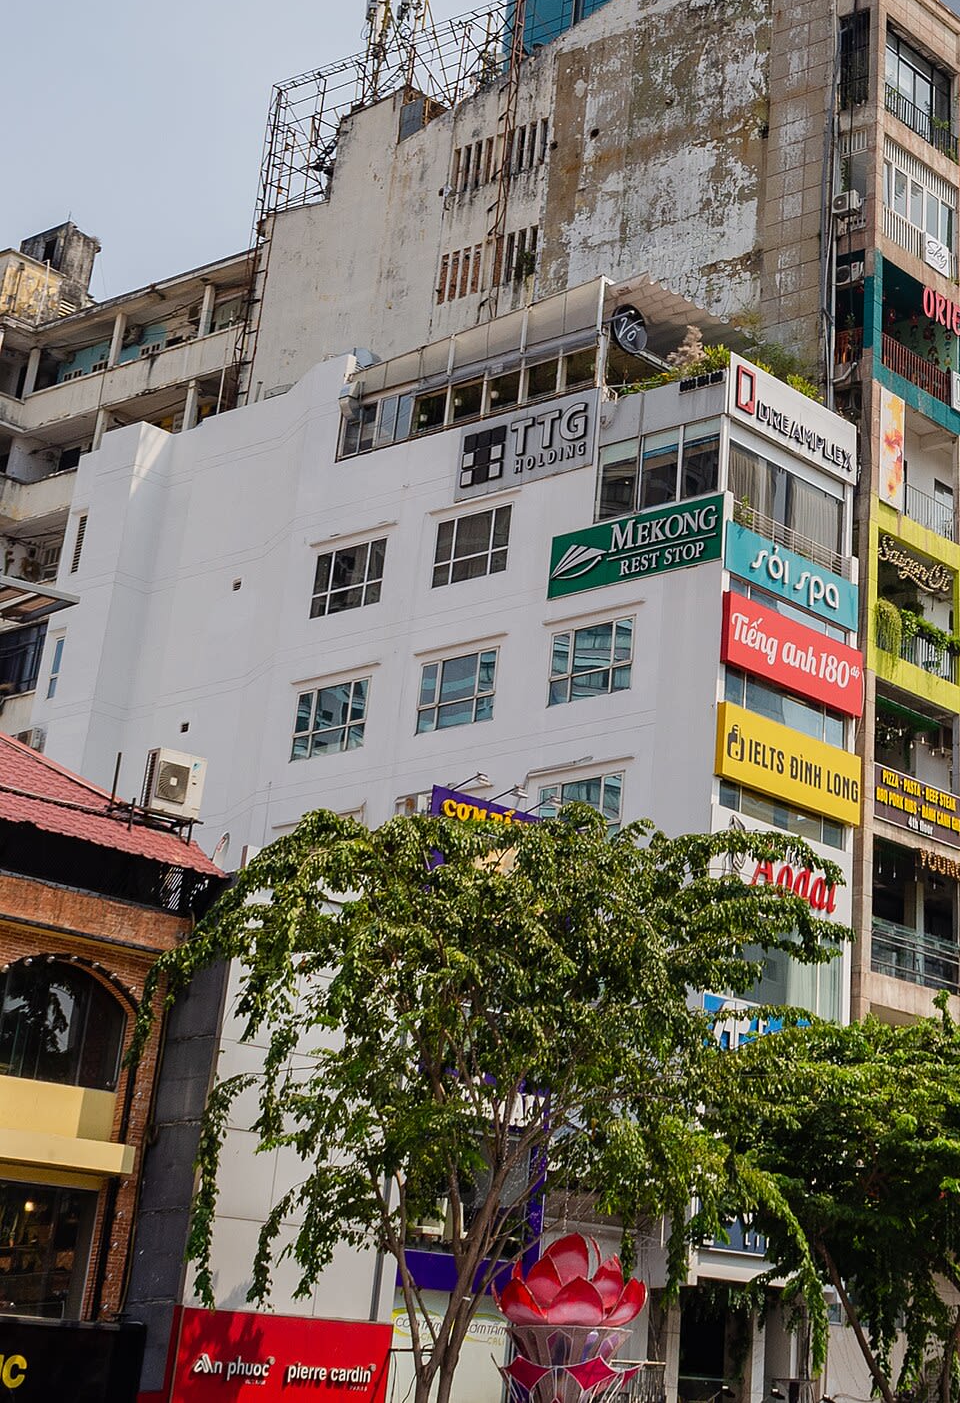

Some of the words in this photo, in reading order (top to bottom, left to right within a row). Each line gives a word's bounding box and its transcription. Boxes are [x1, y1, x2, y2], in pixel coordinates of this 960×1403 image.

[511, 401, 588, 456] TTG
[757, 400, 853, 472] DREAMPLEX
[514, 442, 586, 474] HOLDING
[608, 505, 718, 553] MEKONG
[619, 551, 660, 576] REST
[663, 541, 704, 565] STOP
[731, 612, 779, 666] Tiếng
[819, 652, 850, 689] 180
[749, 739, 785, 775] IELTS
[790, 754, 822, 789] ĐÌNH
[827, 770, 859, 803] LONG
[882, 769, 899, 788] PIZZA
[903, 778, 921, 797] PASTA
[925, 787, 939, 805] BEEF
[939, 792, 957, 812] STEAK
[888, 791, 904, 810] PORK
[904, 798, 918, 815] RIBS
[907, 816, 919, 830] 4th
[227, 1355, 269, 1381] phuoc
[287, 1362, 327, 1382] pierre
[330, 1363, 372, 1384] cardin
